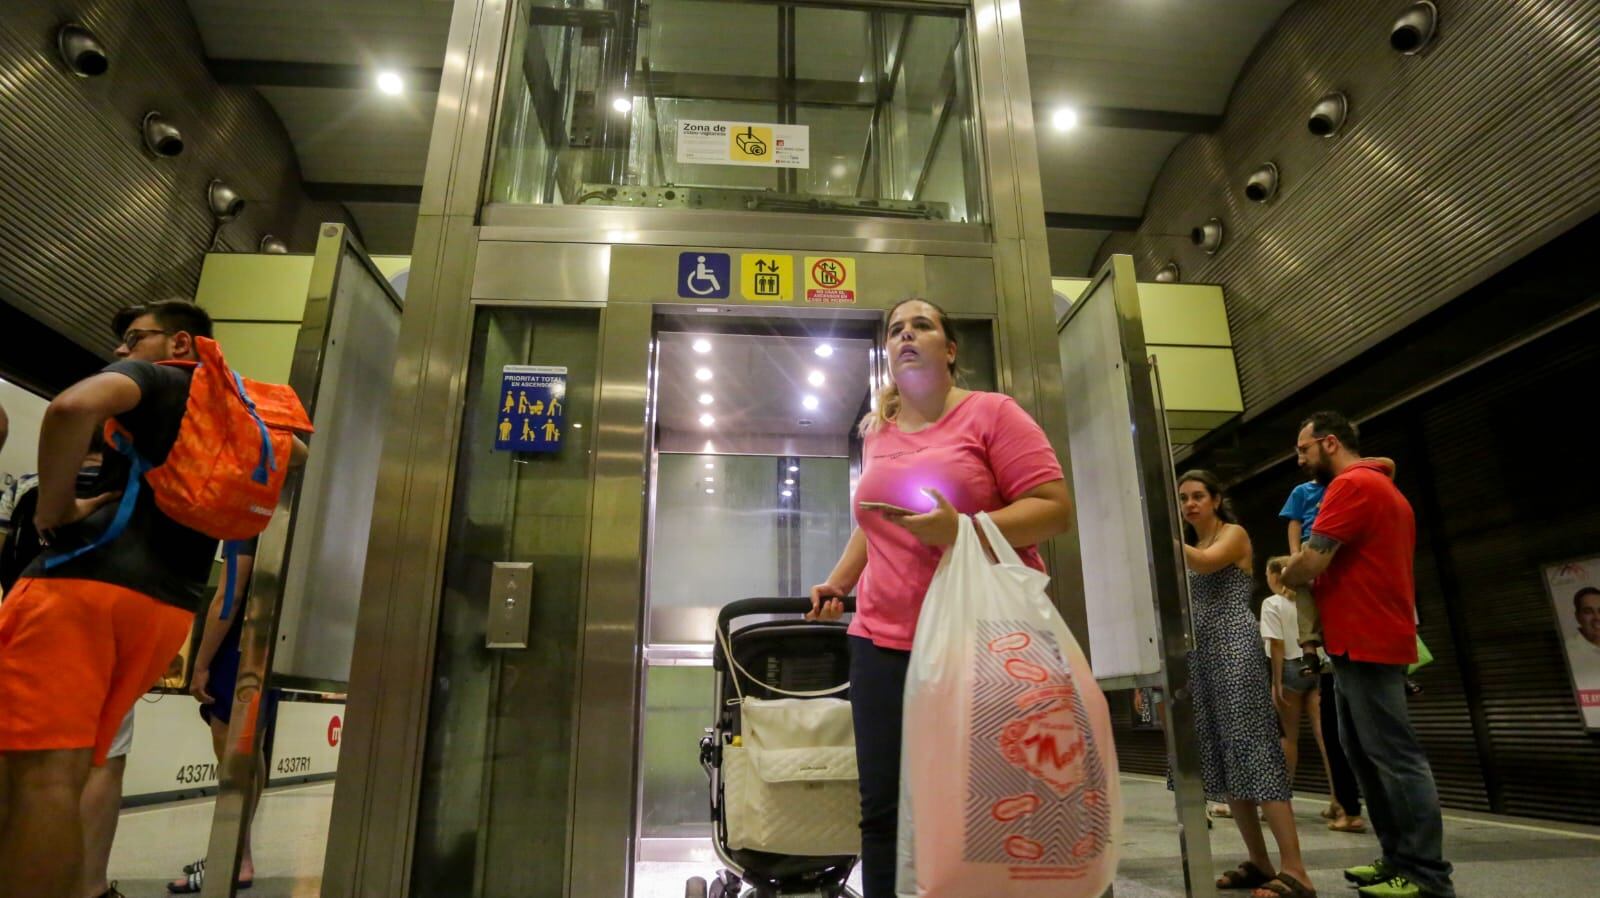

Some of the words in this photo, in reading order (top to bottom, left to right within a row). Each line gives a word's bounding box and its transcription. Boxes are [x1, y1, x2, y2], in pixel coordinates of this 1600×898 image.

[683, 123, 710, 132] Zona
[713, 124, 726, 132] de
[277, 756, 310, 773] 4337R1
